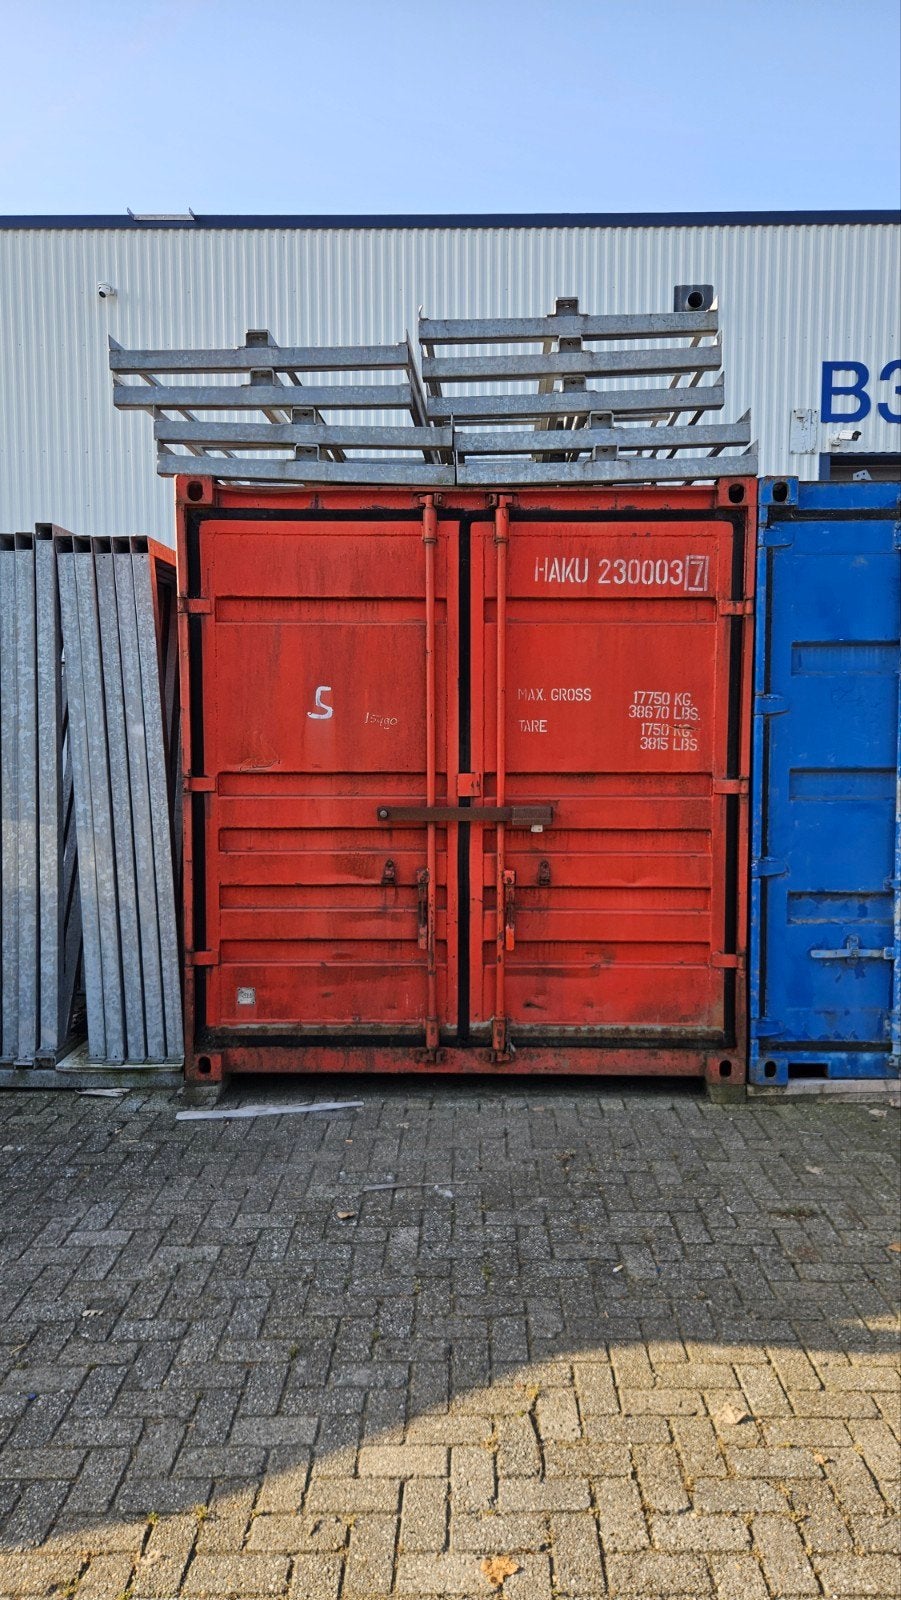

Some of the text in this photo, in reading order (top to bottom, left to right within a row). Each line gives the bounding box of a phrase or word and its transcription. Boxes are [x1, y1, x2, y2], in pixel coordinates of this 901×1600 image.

[534, 557, 589, 583] HAKU
[598, 559, 683, 585] 230003
[517, 688, 592, 701] MAX. GROSS
[633, 690, 694, 706] 17750 KG.
[628, 705, 701, 721] 38670 LBS.
[518, 719, 548, 733] TARE
[640, 723, 670, 736] 1750
[639, 737, 700, 751] 3815 LBS.
